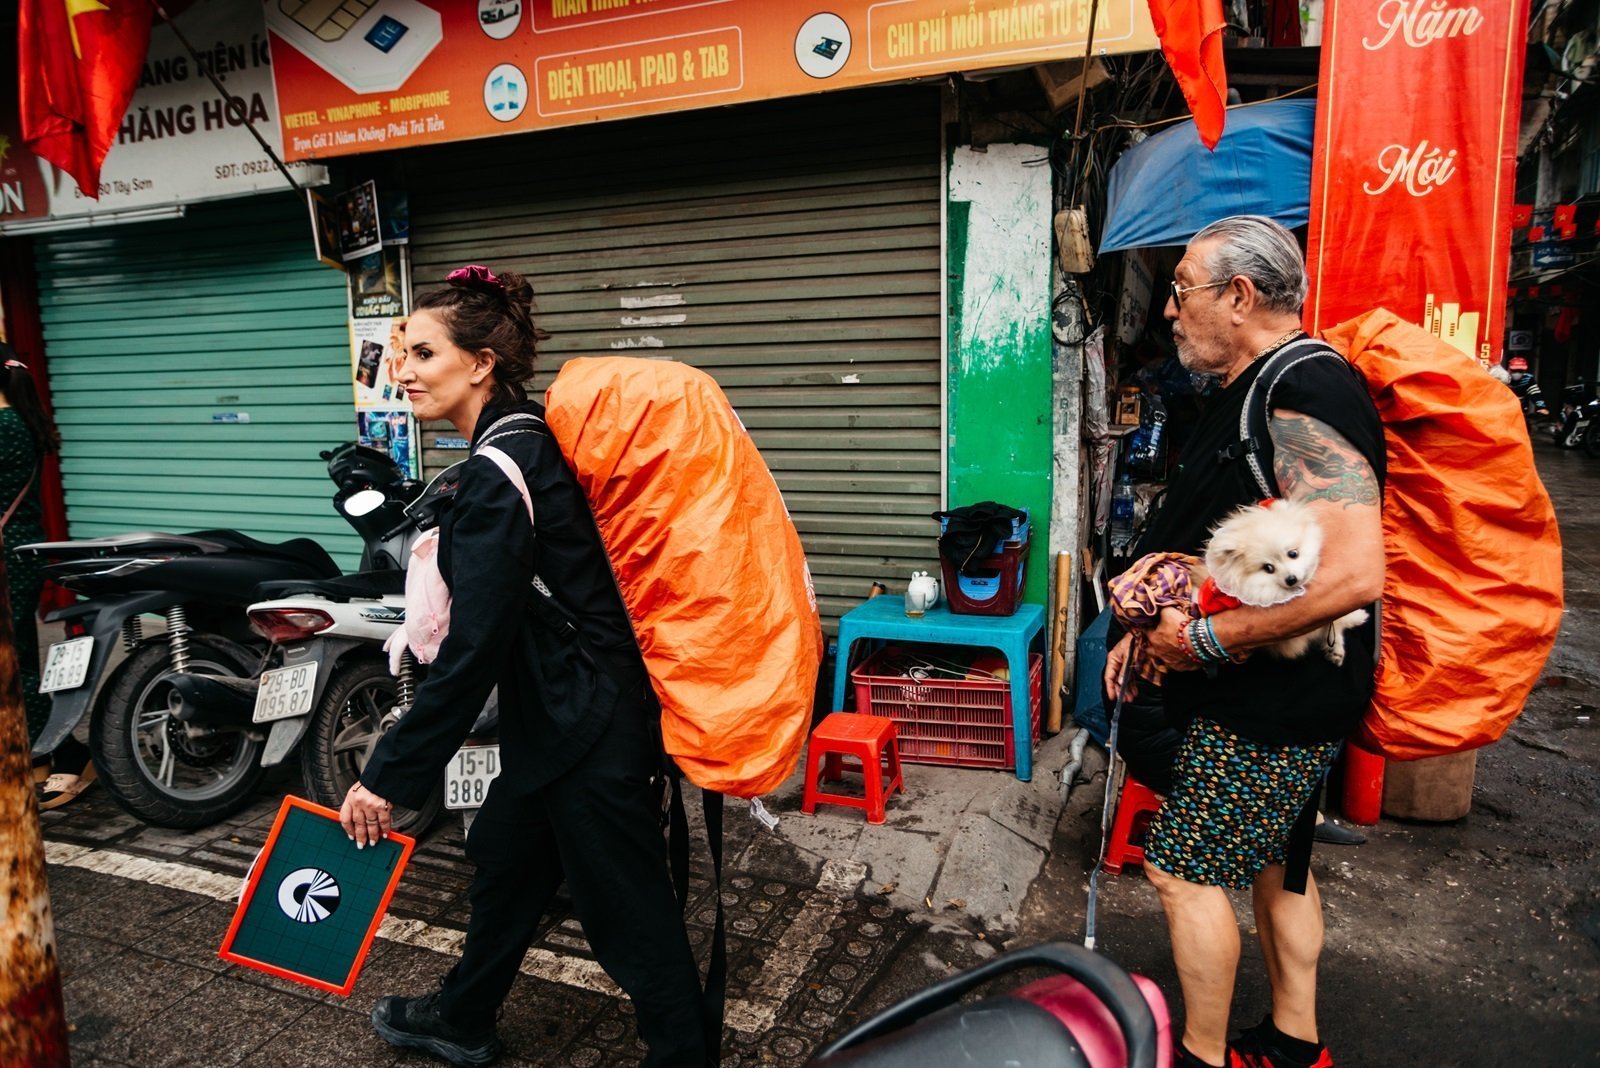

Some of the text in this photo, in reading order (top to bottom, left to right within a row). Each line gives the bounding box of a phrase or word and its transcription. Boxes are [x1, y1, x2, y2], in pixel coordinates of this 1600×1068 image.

[374, 22, 400, 47] LTE
[887, 23, 914, 59] CHI
[918, 11, 947, 55] PHÍ
[988, 0, 1045, 44] THÁNG
[1362, 0, 1484, 51] Năm
[137, 56, 188, 87] ANG
[547, 44, 730, 105] ĐIỆN THOẠI, IPAD & TAB
[119, 92, 270, 145] HĂNG HOA
[284, 111, 320, 129] VIETTEL
[327, 101, 382, 124] VINAPHONE
[390, 90, 450, 113] MOBIPHONE
[328, 132, 334, 146] 1
[1362, 139, 1457, 197] Mới
[0, 181, 25, 214] N
[267, 667, 307, 695] 29-BD
[258, 689, 309, 718] 095.87
[457, 749, 496, 777] 15-D
[449, 778, 484, 804] 388
